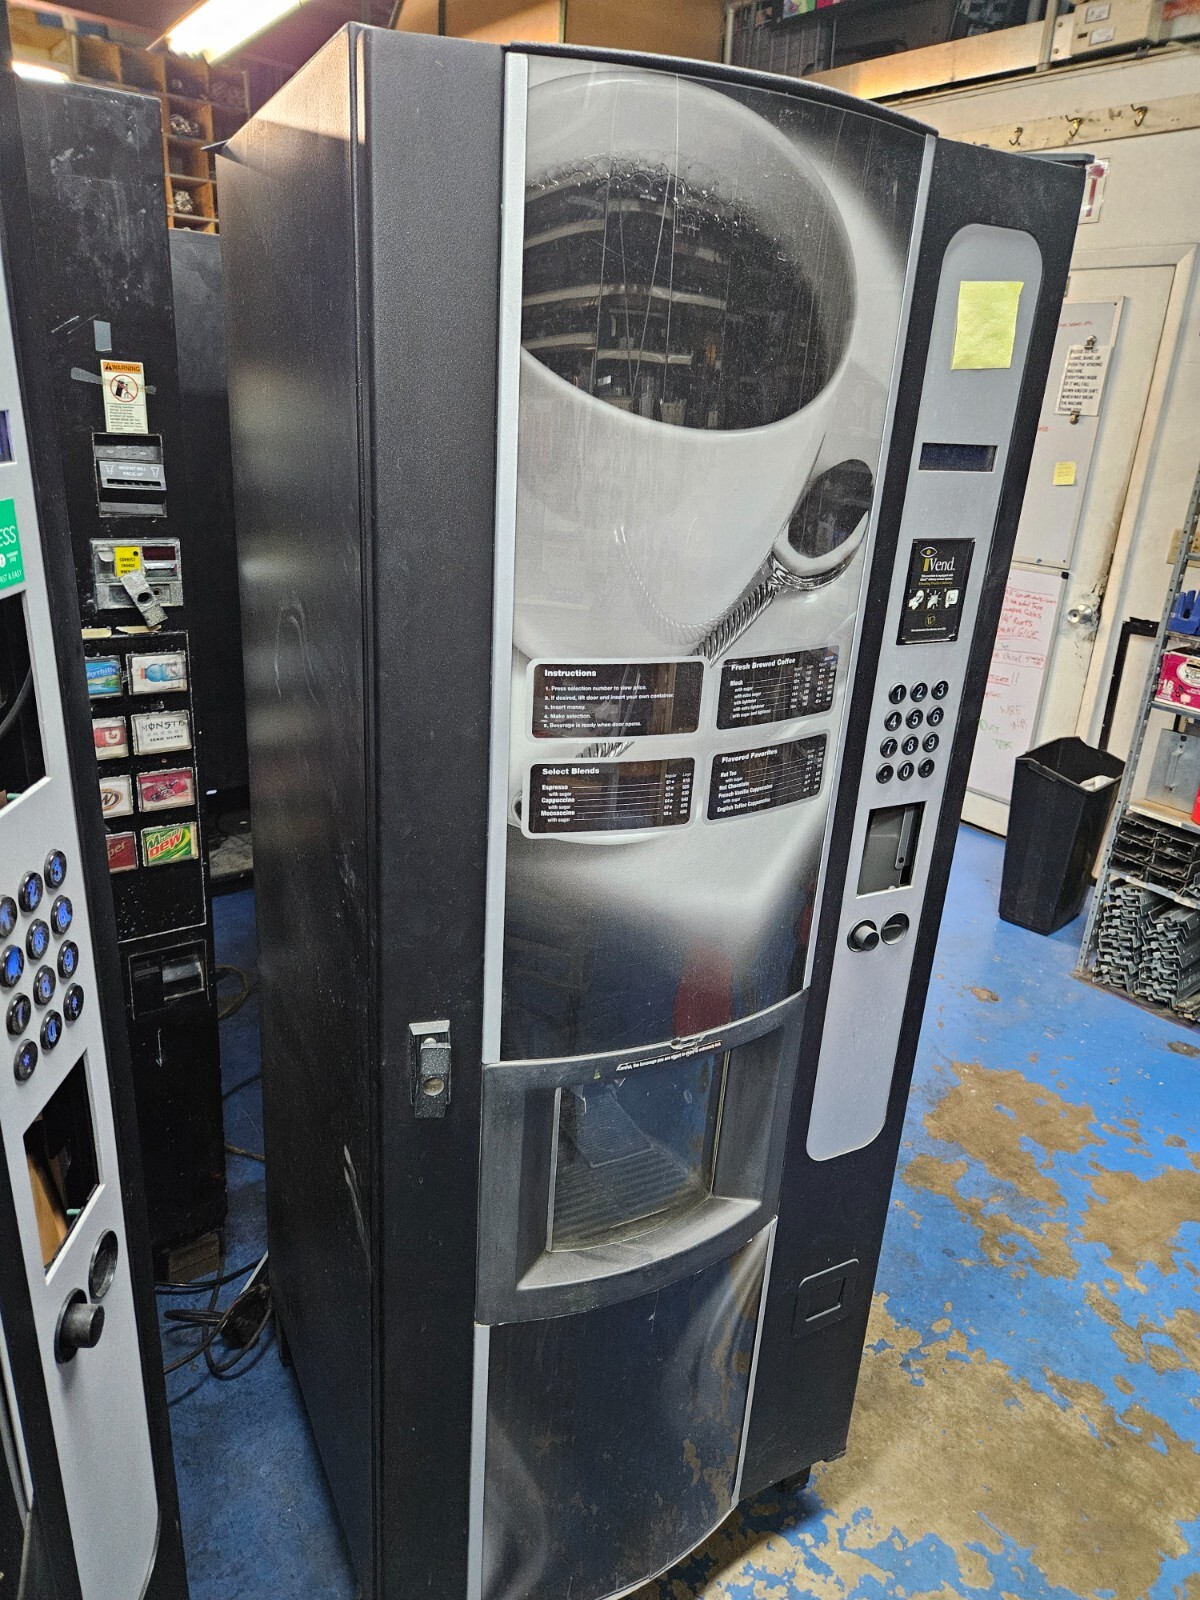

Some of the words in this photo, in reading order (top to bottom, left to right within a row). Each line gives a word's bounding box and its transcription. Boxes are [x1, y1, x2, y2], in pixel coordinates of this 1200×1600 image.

[112, 364, 140, 372] WARNING
[731, 663, 751, 671] Fresh
[751, 660, 776, 669] Brewed
[776, 658, 796, 666] Coffee
[544, 669, 597, 677] Instructions
[896, 687, 902, 701] 1
[916, 685, 923, 698] 2
[937, 683, 945, 696] 3
[890, 715, 897, 728] 4
[912, 712, 919, 725] 5
[932, 710, 940, 723] 6
[887, 741, 894, 755] 7
[907, 739, 914, 752] 8
[927, 736, 935, 749] 9
[721, 753, 750, 763] Flavored
[750, 748, 778, 758] Favorites
[903, 765, 910, 778] 0
